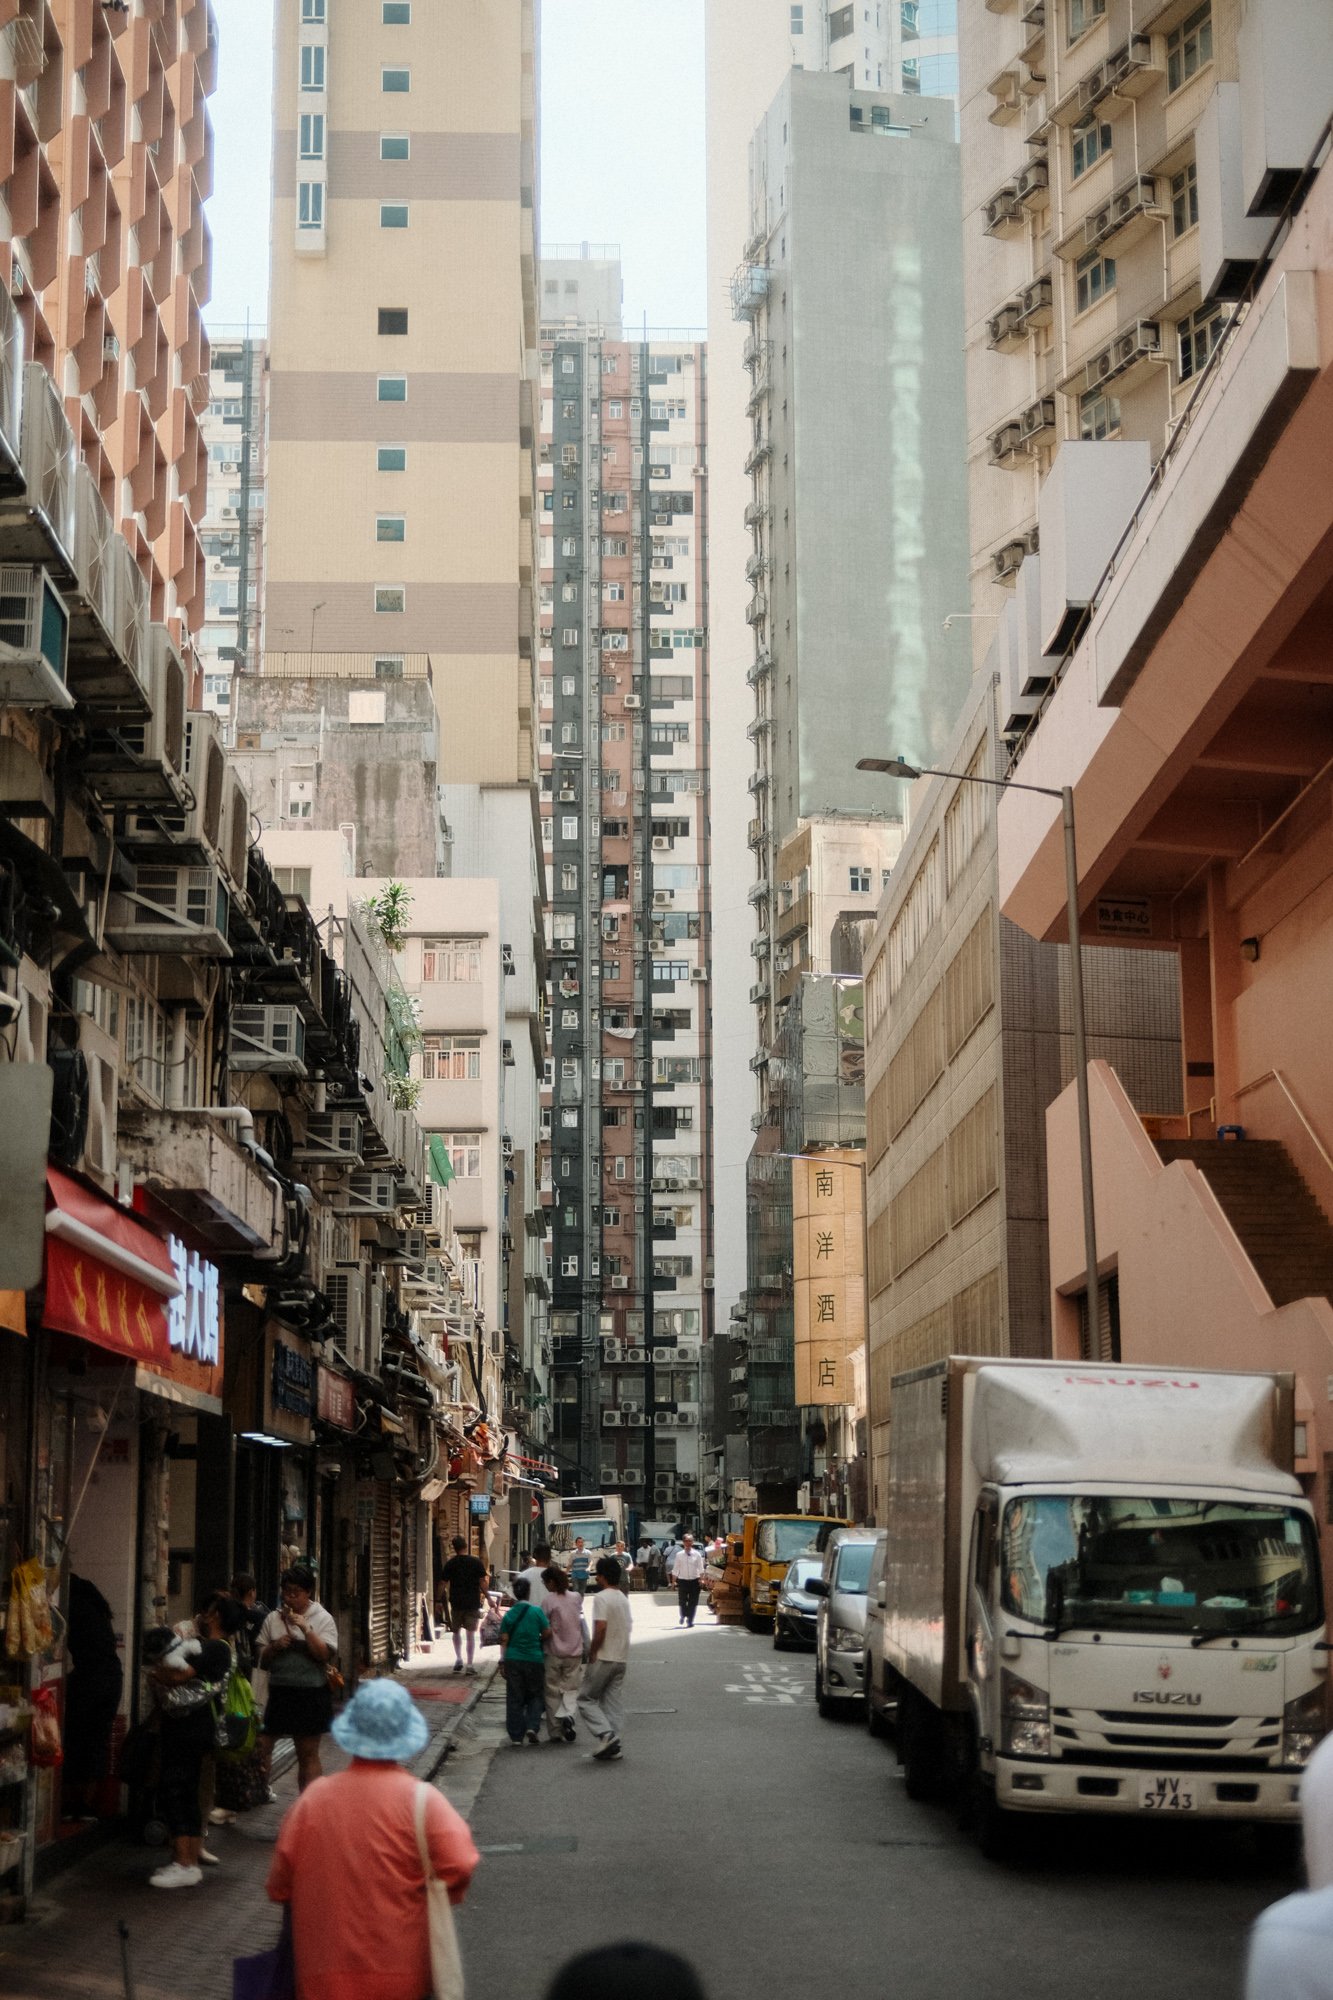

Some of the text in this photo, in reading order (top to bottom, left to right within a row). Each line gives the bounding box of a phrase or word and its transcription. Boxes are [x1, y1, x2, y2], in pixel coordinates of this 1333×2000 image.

[815, 1168, 837, 1388] 南洋酒店
[1064, 1376, 1200, 1389] ISUZU
[1132, 1690, 1202, 1706] ISUZU
[1155, 1777, 1180, 1793] WV
[1143, 1792, 1193, 1809] 5743
